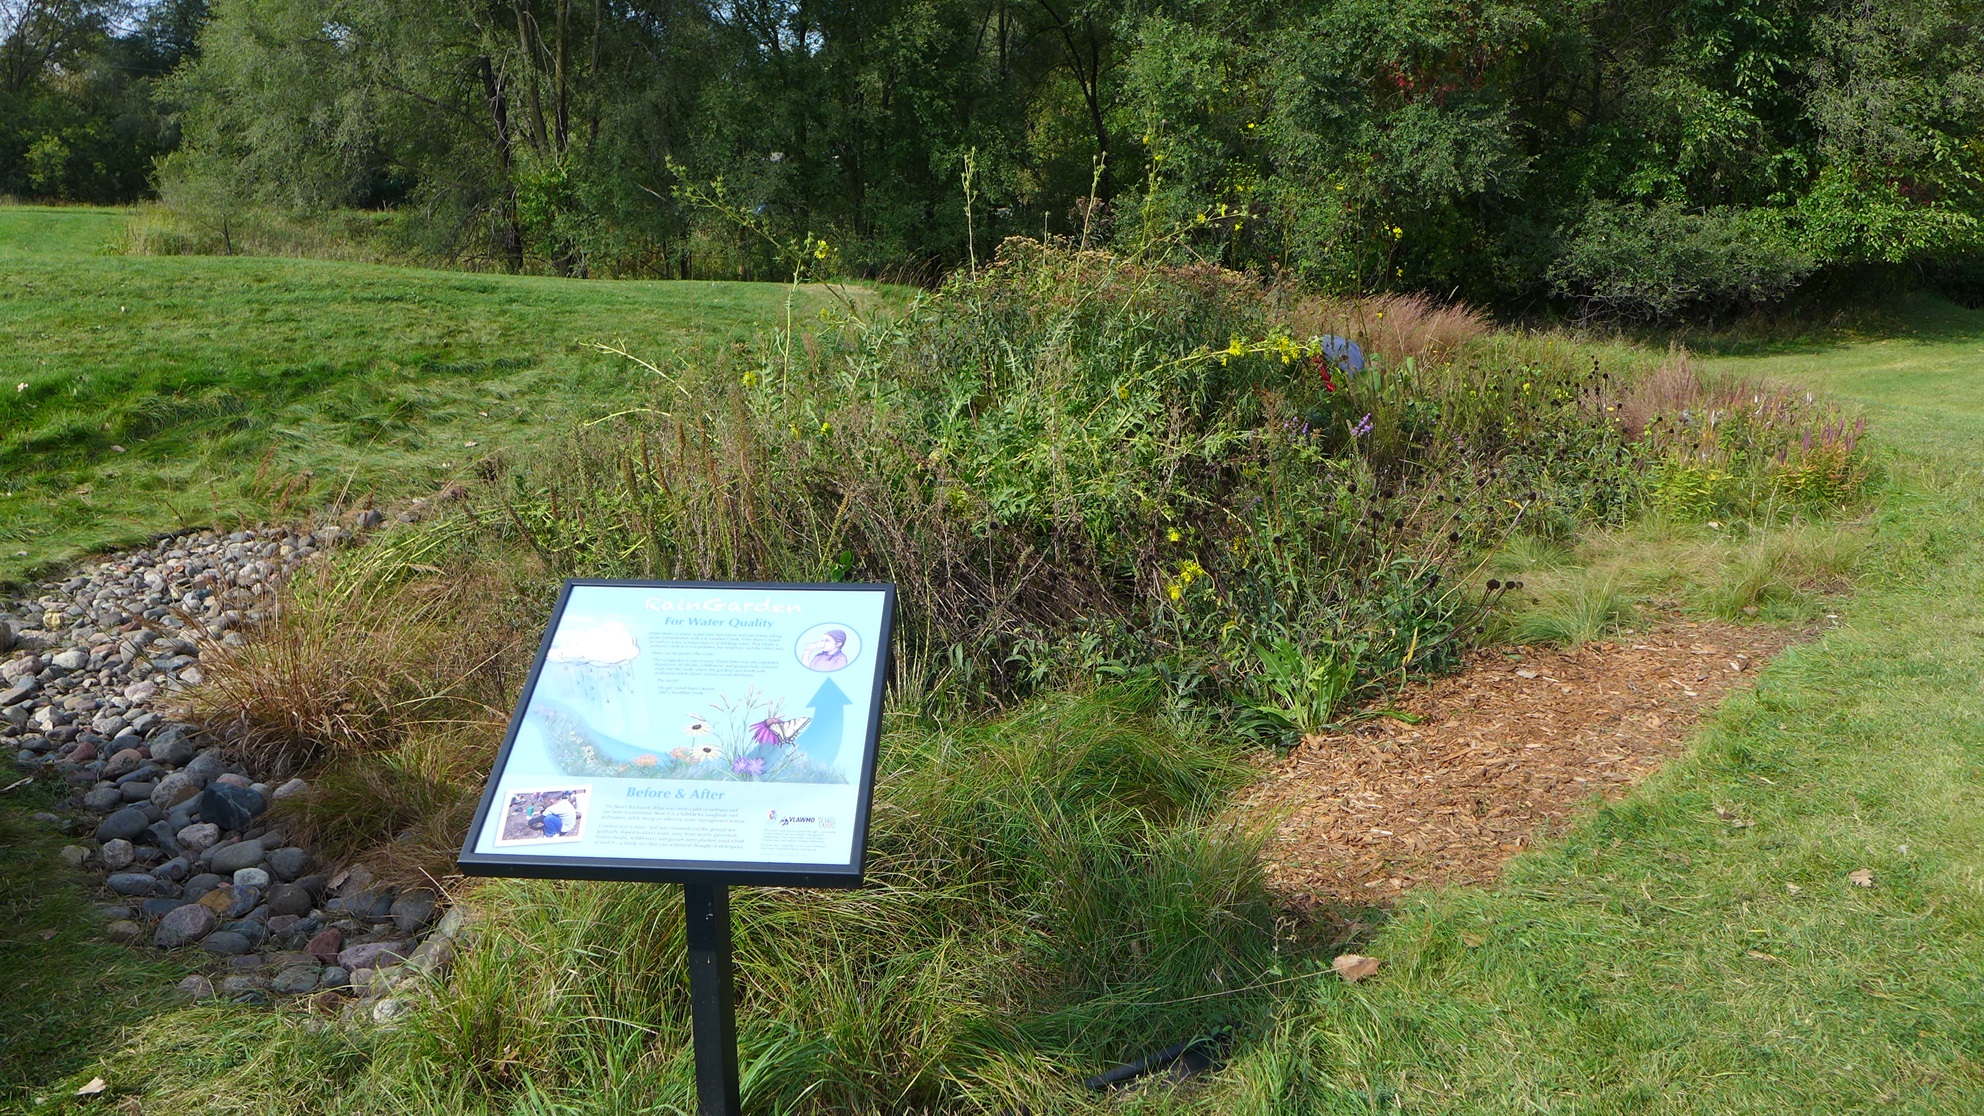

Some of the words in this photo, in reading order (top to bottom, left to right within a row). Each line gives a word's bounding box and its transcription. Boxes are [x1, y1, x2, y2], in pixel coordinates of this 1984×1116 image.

[643, 597, 802, 614] RainGarden
[664, 616, 684, 627] For
[688, 617, 725, 628] Water
[728, 618, 775, 630] Quality
[626, 786, 671, 799] Before
[674, 787, 686, 799] &
[689, 788, 726, 800] After
[788, 816, 816, 824] VLAWMO
